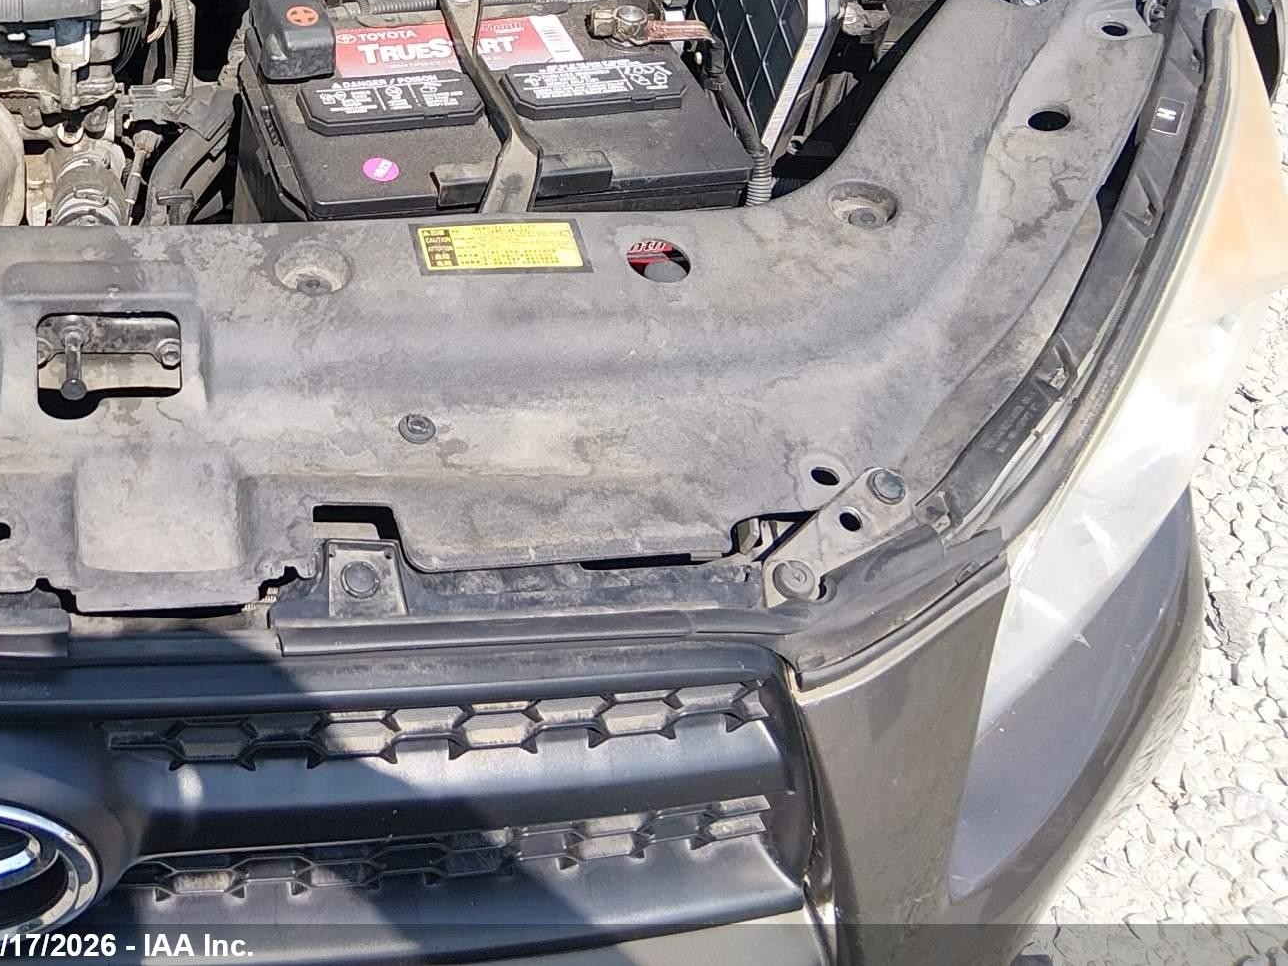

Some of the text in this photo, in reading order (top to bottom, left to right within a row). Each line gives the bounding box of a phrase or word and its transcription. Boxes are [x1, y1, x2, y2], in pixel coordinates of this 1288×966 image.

[357, 29, 418, 41] TOYOTA
[342, 79, 387, 89] DANGER
[397, 74, 438, 84] POISON
[425, 236, 452, 244] CAUTION
